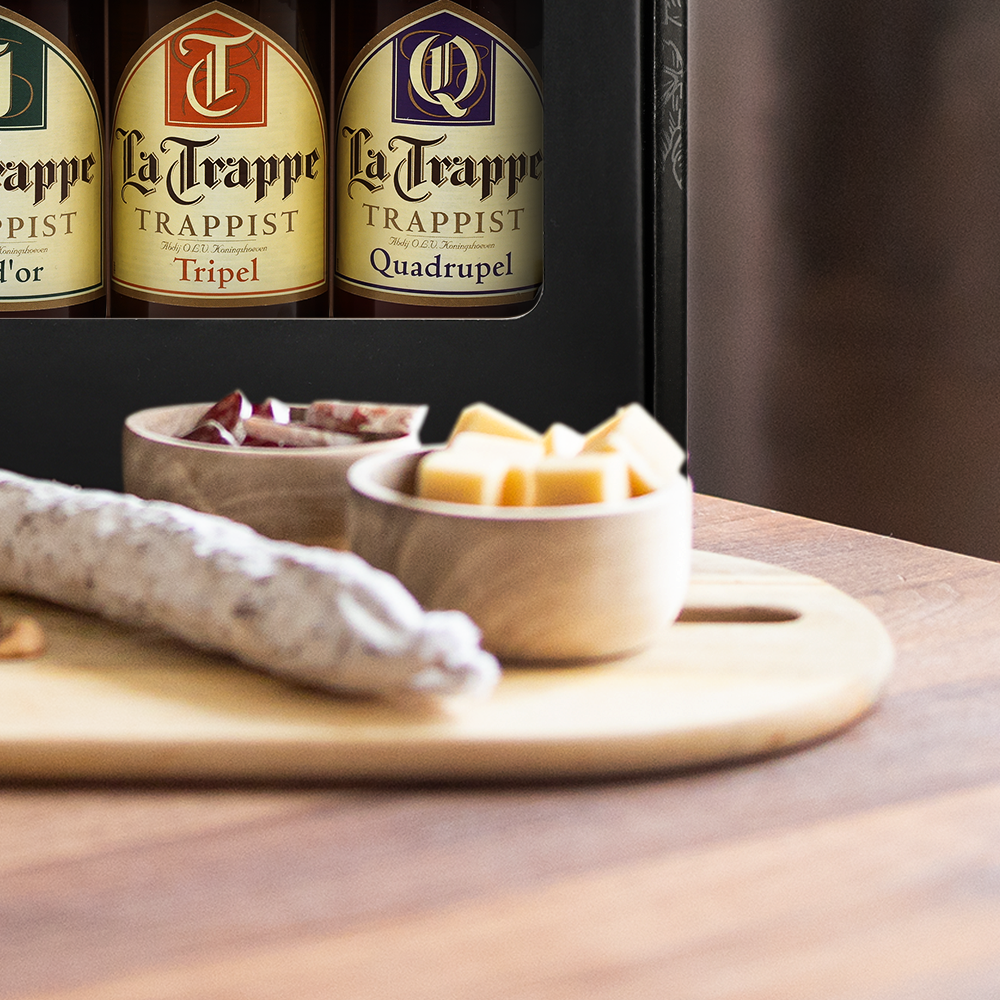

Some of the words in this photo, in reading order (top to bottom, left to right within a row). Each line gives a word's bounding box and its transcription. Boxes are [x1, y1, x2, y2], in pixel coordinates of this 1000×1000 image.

[408, 33, 481, 118] Q
[116, 128, 163, 204] La
[160, 134, 320, 206] Trappe
[342, 126, 391, 200] La
[388, 134, 543, 203] Trappe
[135, 207, 299, 237] TRAPPIST
[362, 203, 525, 234] TRAPPIST
[173, 257, 260, 290] Tripel
[369, 247, 514, 285] Quadrupel
